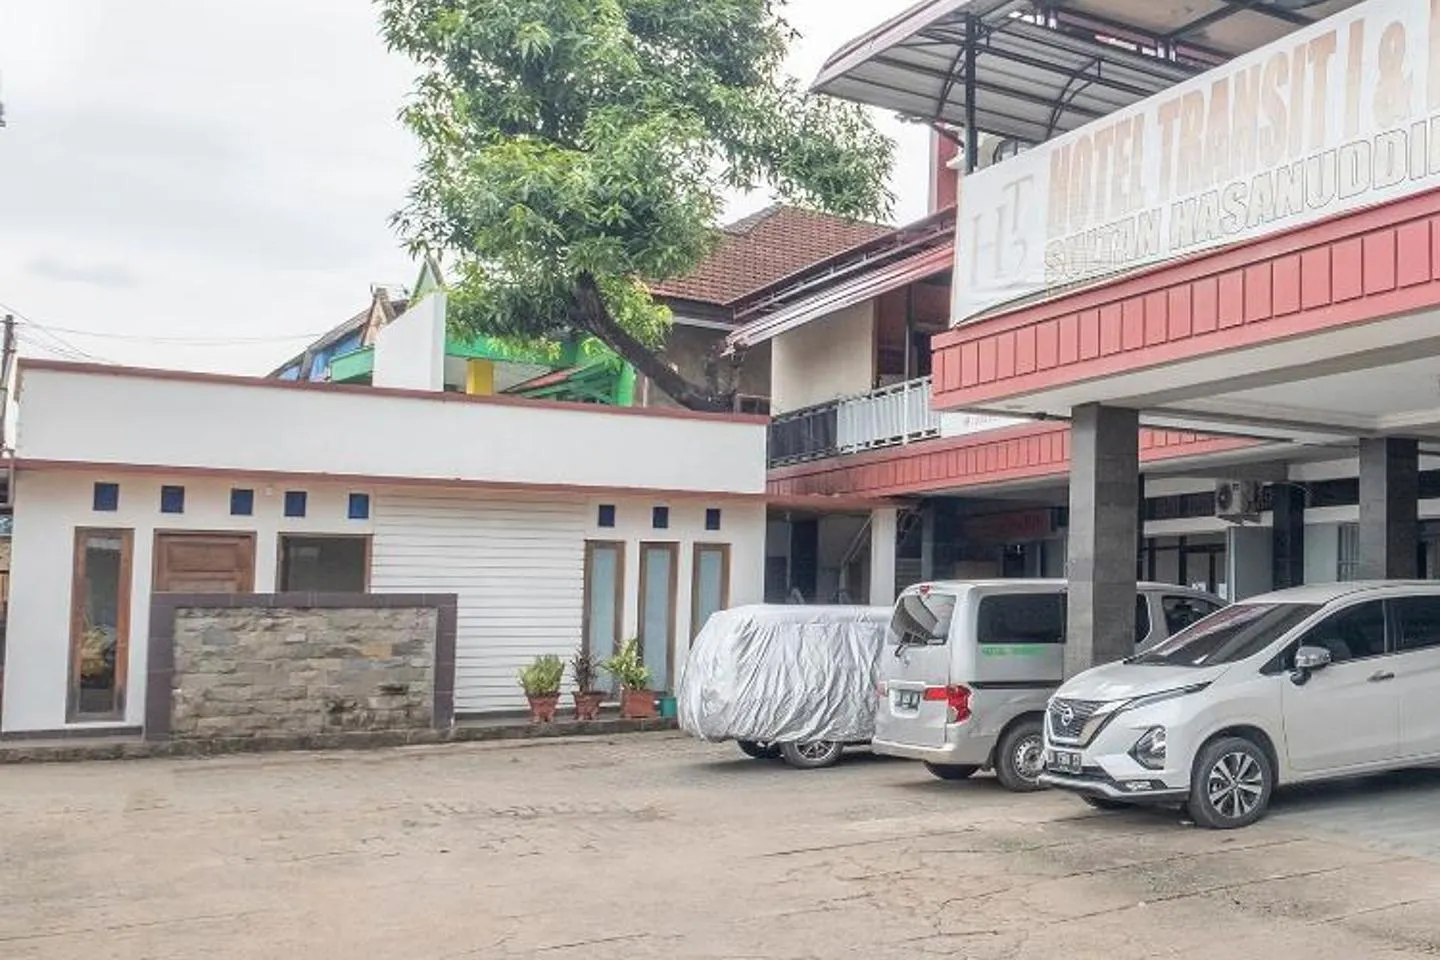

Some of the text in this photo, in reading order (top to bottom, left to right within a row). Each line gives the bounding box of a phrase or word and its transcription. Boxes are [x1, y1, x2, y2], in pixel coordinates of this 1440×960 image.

[1047, 113, 1145, 238] HOTEL
[1158, 29, 1337, 201] TRANSIT
[1373, 20, 1412, 127] &
